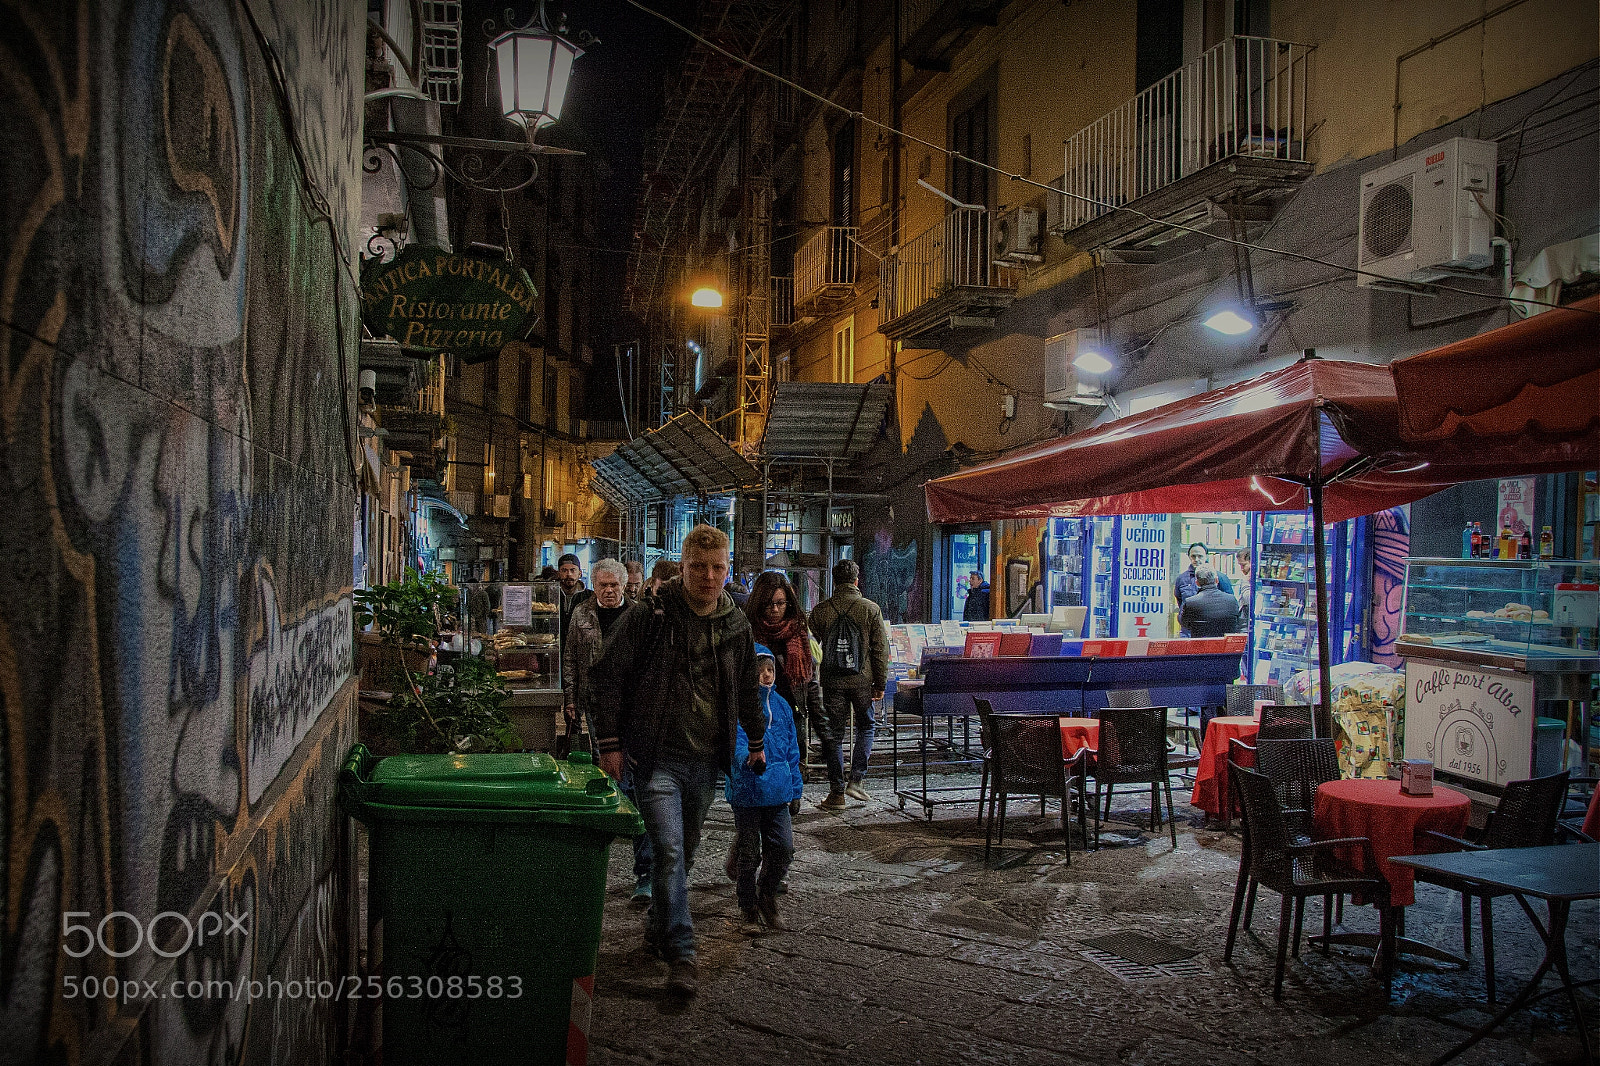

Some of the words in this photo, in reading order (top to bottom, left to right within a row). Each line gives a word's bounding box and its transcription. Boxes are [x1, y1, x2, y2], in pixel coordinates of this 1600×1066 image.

[364, 258, 432, 310] ANTICA
[389, 294, 513, 321] Ristorante
[403, 321, 504, 348] Pizzeria
[1126, 528, 1165, 543] VENDO
[1124, 548, 1165, 568] LIBRI
[1123, 585, 1162, 597] USATI
[1122, 601, 1164, 614] NUOVI
[1415, 668, 1450, 704] Caffè
[1448, 758, 1462, 770] dal
[1463, 761, 1481, 775] 1956
